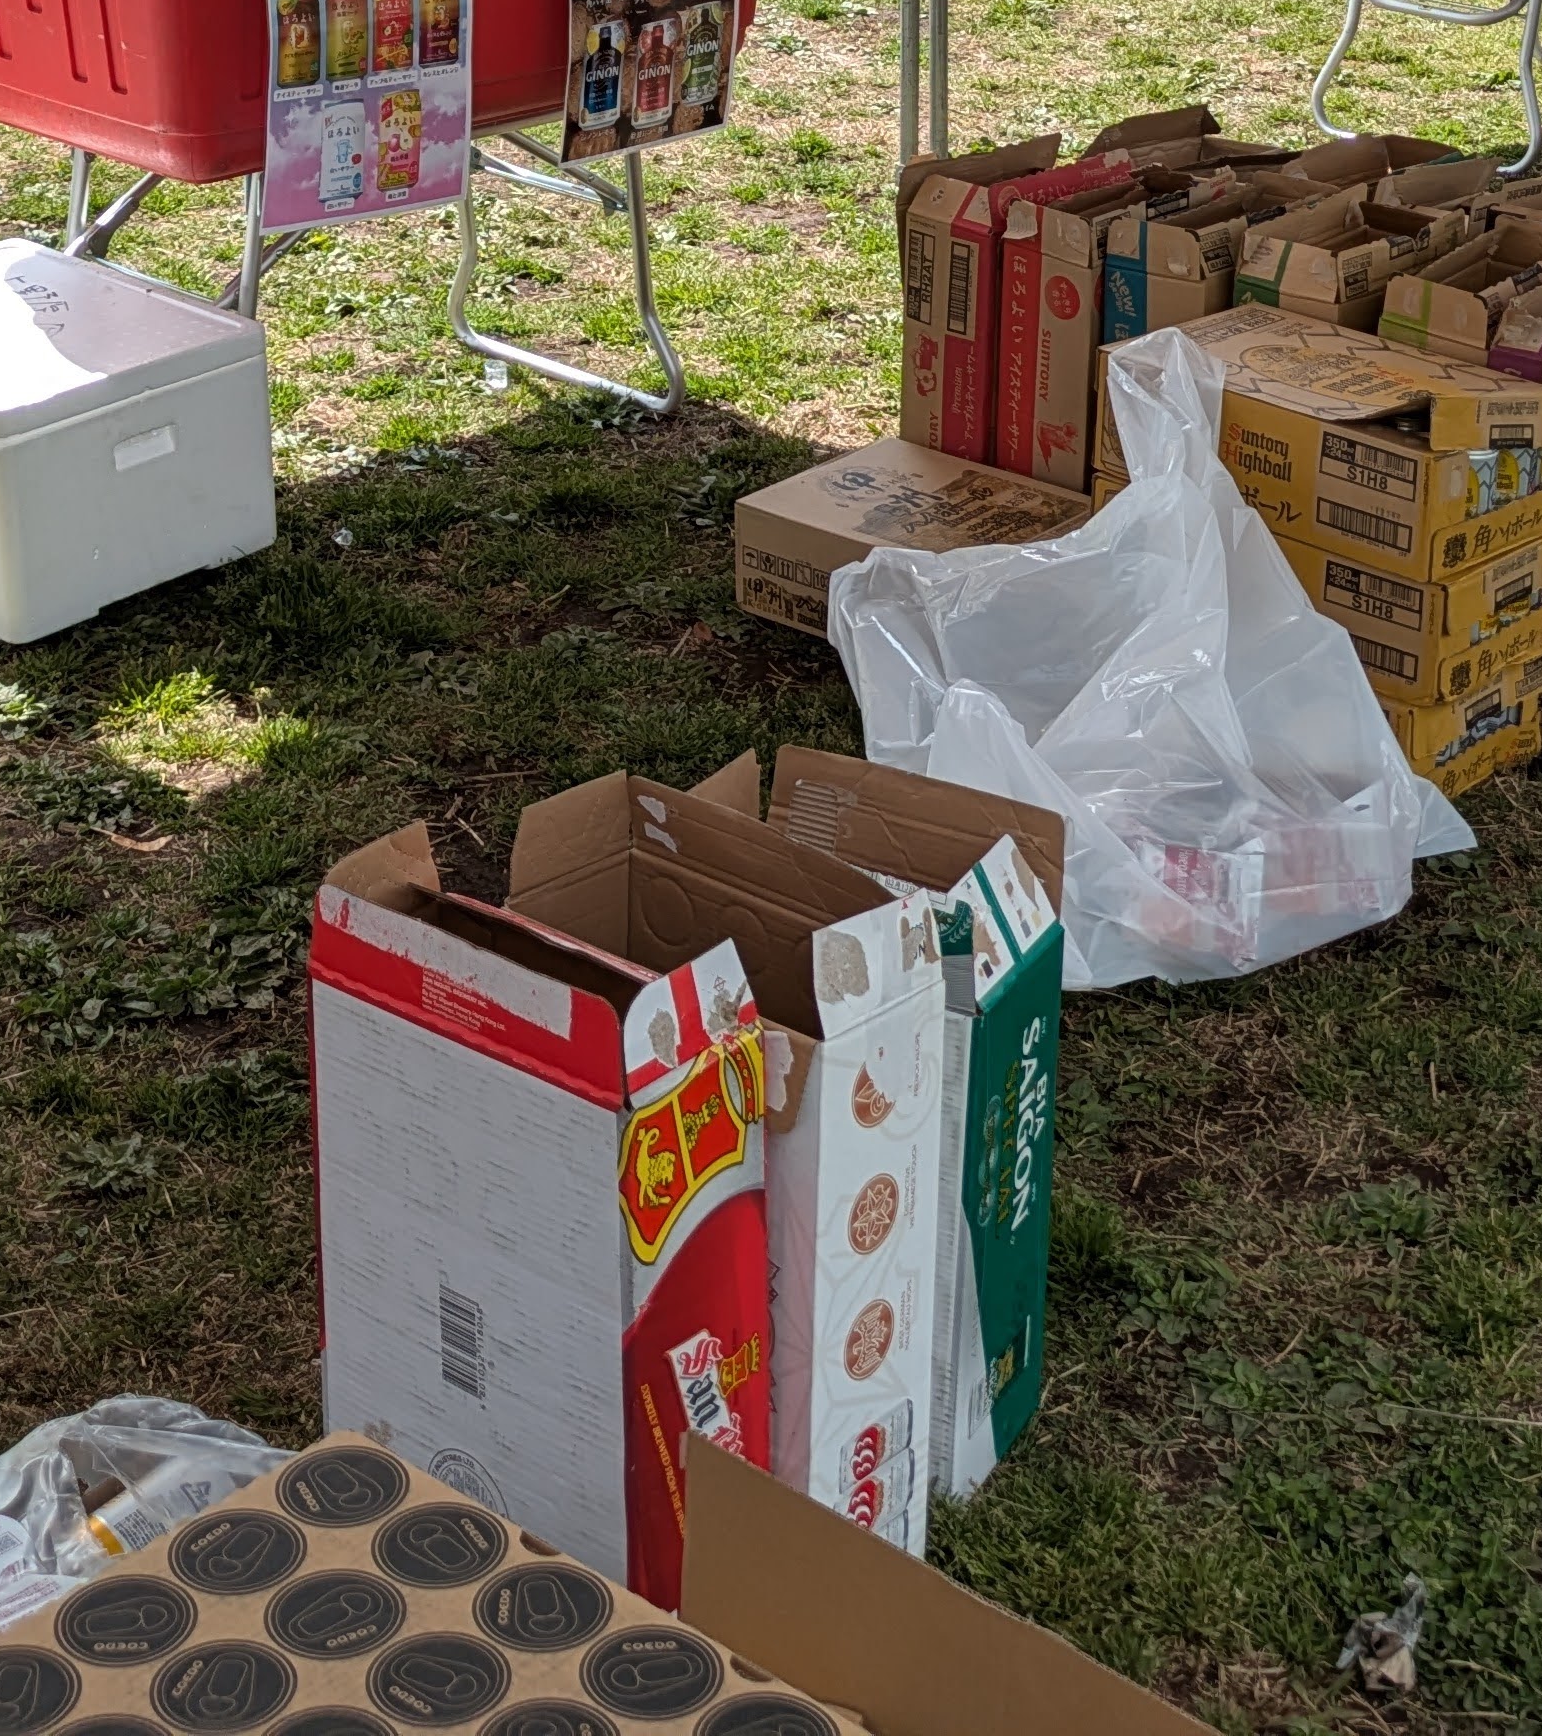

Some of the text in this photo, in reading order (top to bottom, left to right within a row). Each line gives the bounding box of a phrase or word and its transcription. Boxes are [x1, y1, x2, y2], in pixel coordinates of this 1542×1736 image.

[283, 12, 315, 25] ほろよい
[687, 40, 719, 56] GINON
[586, 66, 619, 81] GINON
[638, 63, 671, 80] GINON
[328, 127, 359, 138] ほろよい
[385, 116, 416, 127] ほろよい
[921, 259, 934, 305] RH2AT
[1111, 270, 1137, 318] New!
[1009, 255, 1027, 461] ほろよい アイスティーサワー
[1038, 328, 1051, 402] SUNTORY
[928, 411, 941, 449] TORY
[1227, 423, 1289, 458] Suntory
[1221, 440, 1292, 482] Highball
[1347, 466, 1388, 490] S1H8
[746, 577, 782, 611] 甲州
[1351, 594, 1394, 620] S1H8
[1476, 629, 1538, 683] 角ハイボール
[1033, 1072, 1049, 1141] BIA
[1011, 1016, 1041, 1233] SAIGON
[679, 1337, 723, 1429] San
[640, 1383, 658, 1428] EXPERTLY
[652, 1426, 670, 1464] BREWED
[664, 1463, 677, 1494] FROM
[295, 1481, 322, 1512] COEDO
[190, 1521, 232, 1553] COEDO
[460, 1516, 490, 1551] COEDO
[496, 1588, 511, 1626] COEDO
[93, 1640, 149, 1652] COEDO
[326, 1624, 378, 1649] COEDO
[621, 1640, 678, 1652] COEDO
[171, 1659, 204, 1698] COEDO
[388, 1684, 434, 1715] COEDO
